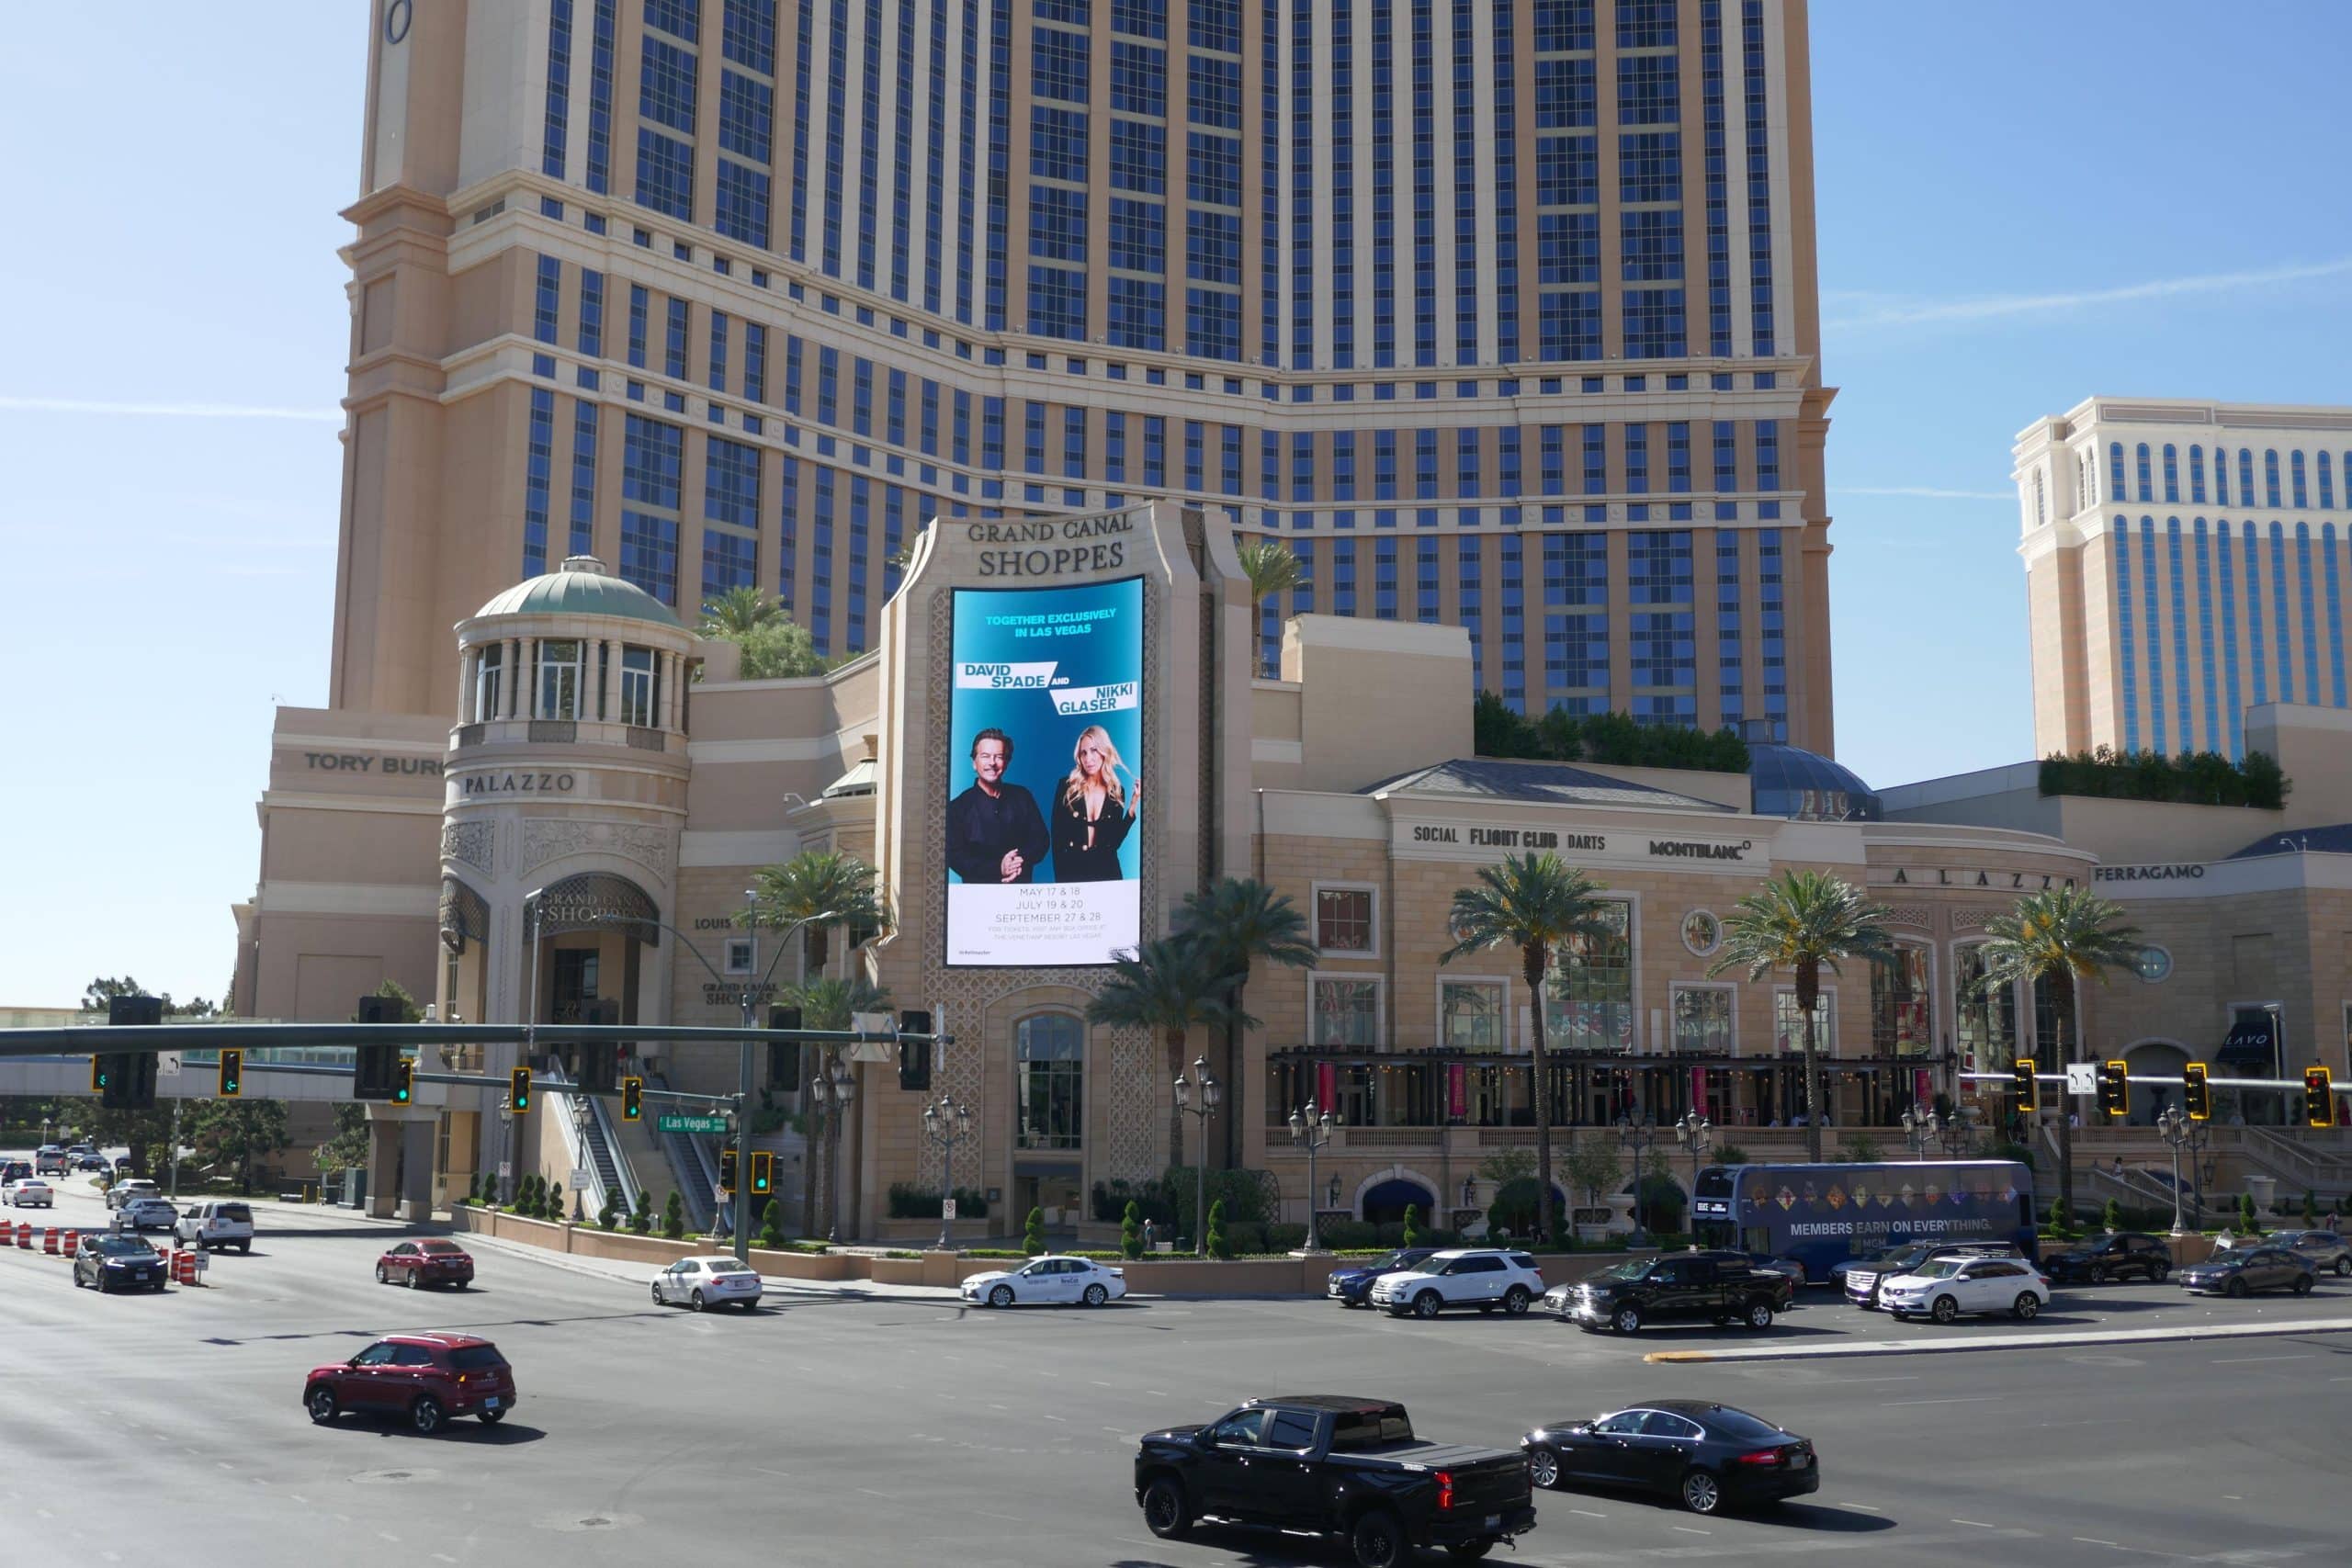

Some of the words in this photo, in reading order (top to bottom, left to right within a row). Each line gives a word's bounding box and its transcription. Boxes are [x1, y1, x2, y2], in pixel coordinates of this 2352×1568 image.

[968, 524, 1055, 542] GRAND
[1063, 514, 1134, 537] CANAL
[978, 541, 1124, 576] SHOPPES
[985, 615, 1046, 626] TOGETHER
[1047, 608, 1116, 624] EXCLUSIVELY
[1015, 628, 1027, 637] IN
[1030, 626, 1052, 637] LAS
[1055, 624, 1091, 636] VEGAS
[965, 664, 1011, 676] DAVID
[991, 675, 1046, 688] SPADE
[1051, 677, 1069, 685] AND
[1096, 683, 1133, 699] NIKKI
[1059, 698, 1116, 714] GLASER
[304, 752, 375, 773] TORY
[466, 773, 574, 794] PALAZZO
[1414, 826, 1459, 843] SOCIAL
[1470, 829, 1520, 847] FLIGHT
[1522, 831, 1558, 849] CLUB
[1568, 834, 1606, 851] DARTS
[1649, 840, 1743, 861] MONTBLANC
[2095, 864, 2205, 882] FERRAGAMO
[1020, 888, 1043, 897] MAY
[1047, 888, 1057, 897] 17
[1060, 887, 1067, 896] &
[1070, 887, 1080, 896] 18
[1016, 901, 1042, 910] JULY
[1046, 900, 1057, 909] 19
[1060, 900, 1067, 909] &
[1071, 900, 1084, 908] 20
[695, 919, 731, 930] LOUIS
[995, 914, 1060, 923] SEPTEMBER
[1064, 913, 1076, 922] 27
[1080, 912, 1086, 921] &
[1090, 912, 1101, 920] 28
[2225, 1034, 2268, 1045] LAVO
[666, 1117, 682, 1129] Las
[684, 1117, 710, 1132] Vegas
[1791, 1223, 1853, 1235] MEMBERS
[1857, 1222, 1889, 1234] EARN
[1893, 1221, 1911, 1233] ON
[1914, 1218, 1992, 1233] EVERYTHING.
